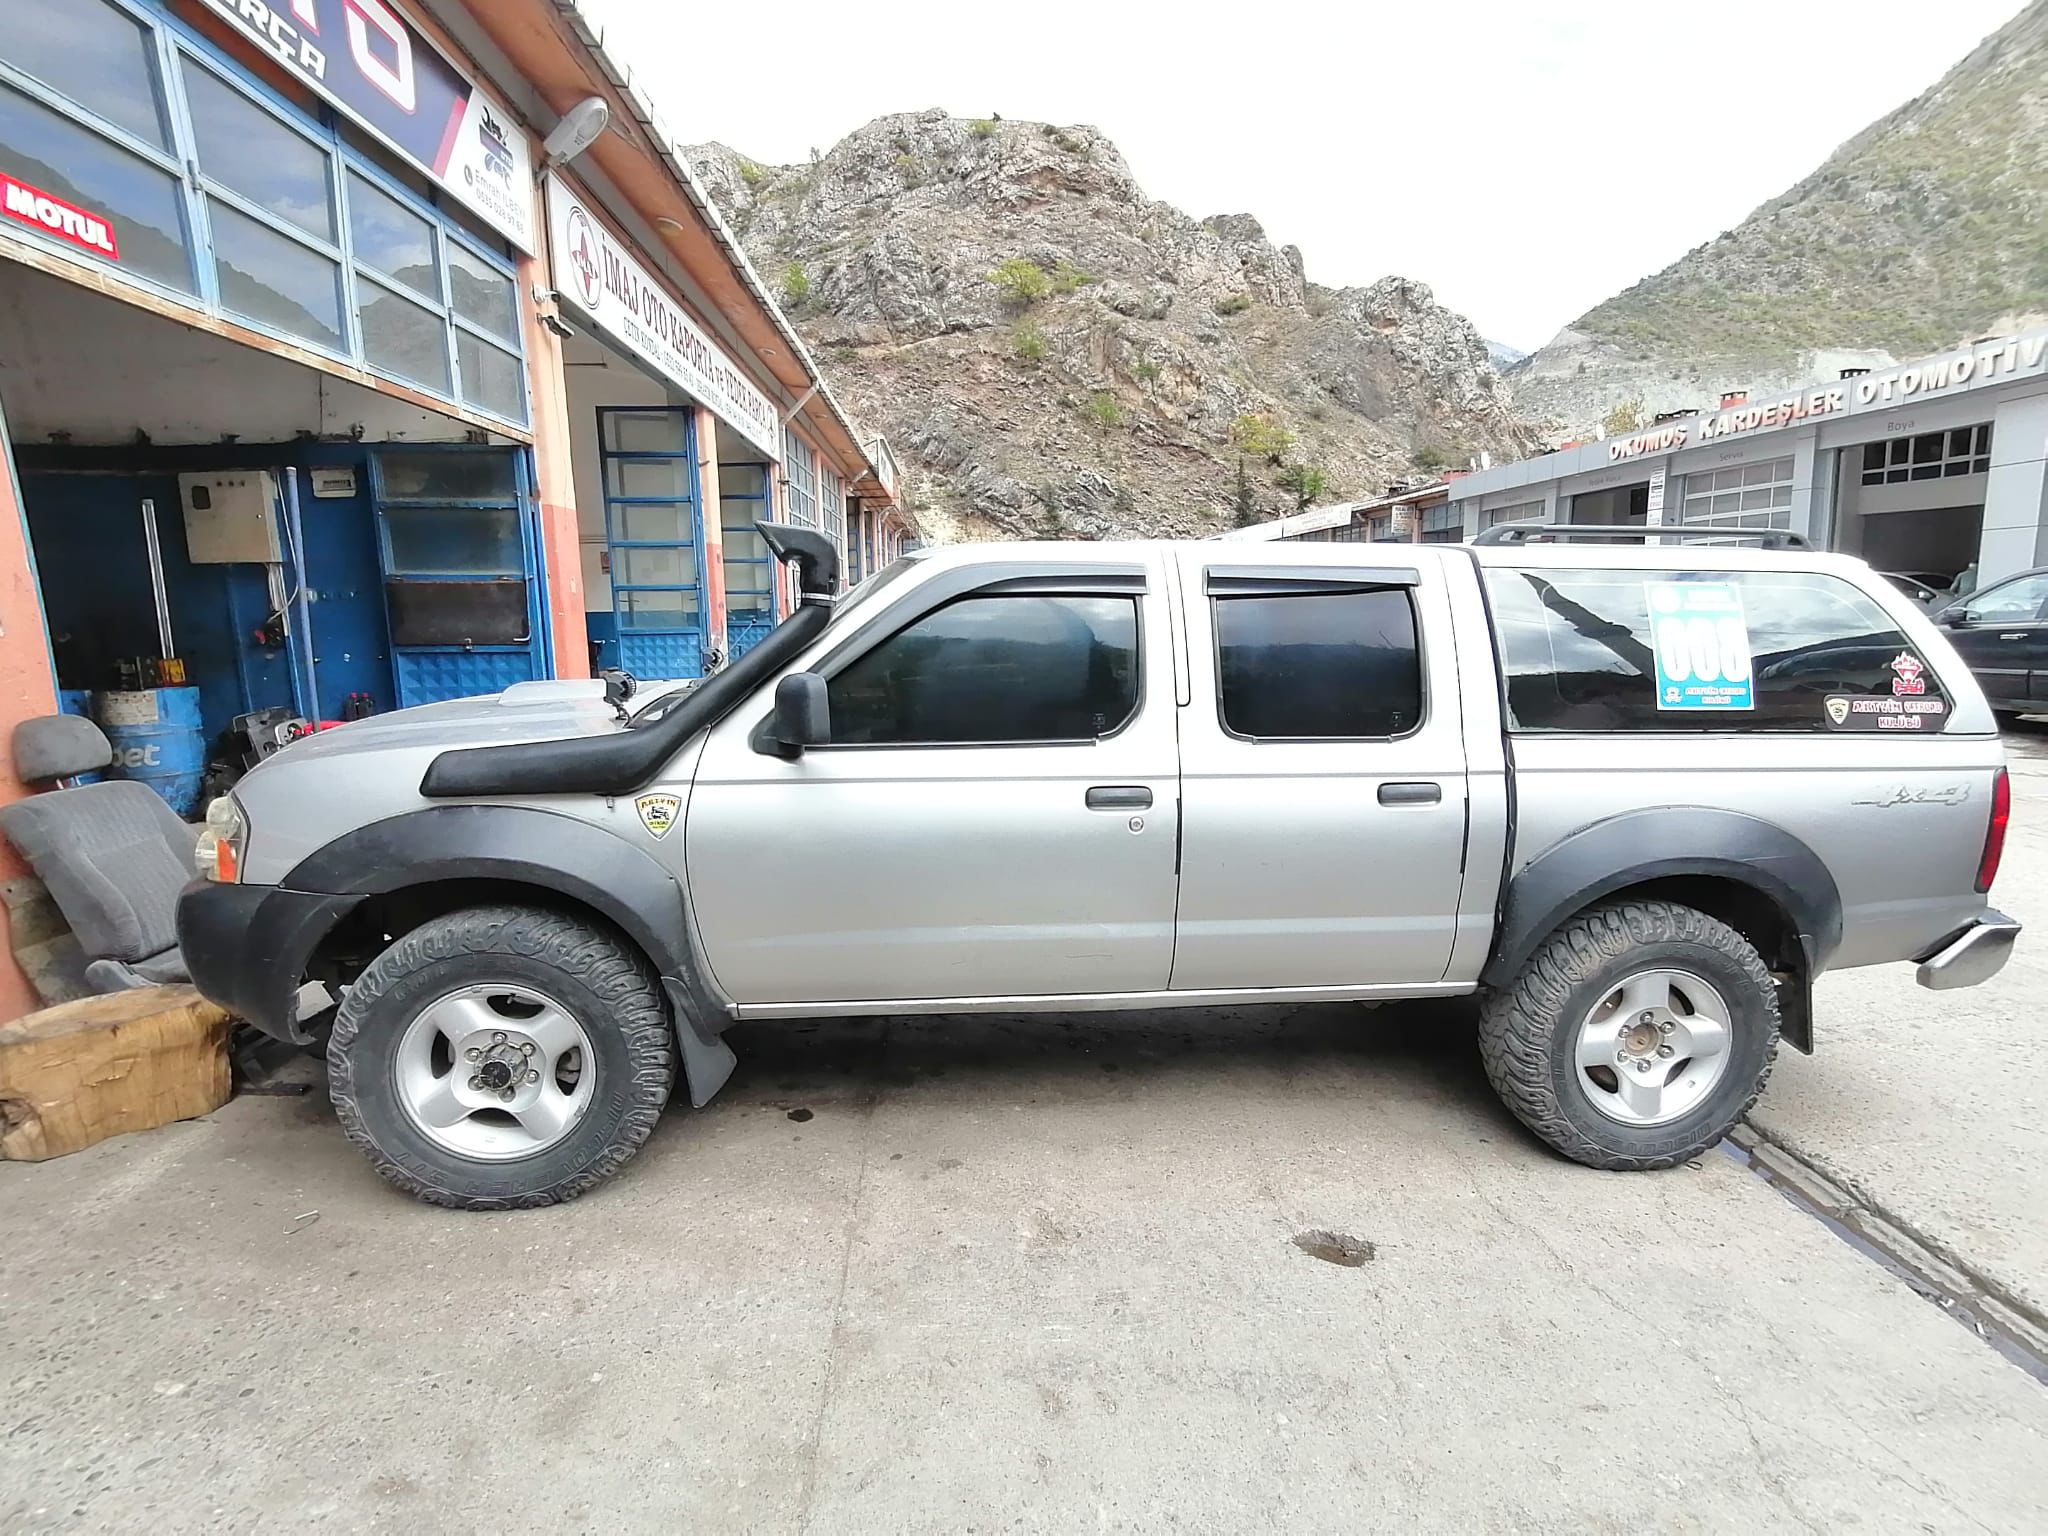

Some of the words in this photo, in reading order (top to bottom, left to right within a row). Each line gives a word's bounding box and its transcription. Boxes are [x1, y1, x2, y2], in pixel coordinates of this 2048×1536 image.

[213, 0, 326, 80] RÇA
[6, 182, 114, 252] MOTUL
[642, 286, 668, 342] OTO
[669, 311, 715, 384] KAPORTA
[1608, 424, 1688, 461] OKUMUŞ
[1700, 388, 1843, 441] KARDEŞLER
[1887, 420, 1915, 432] Boya
